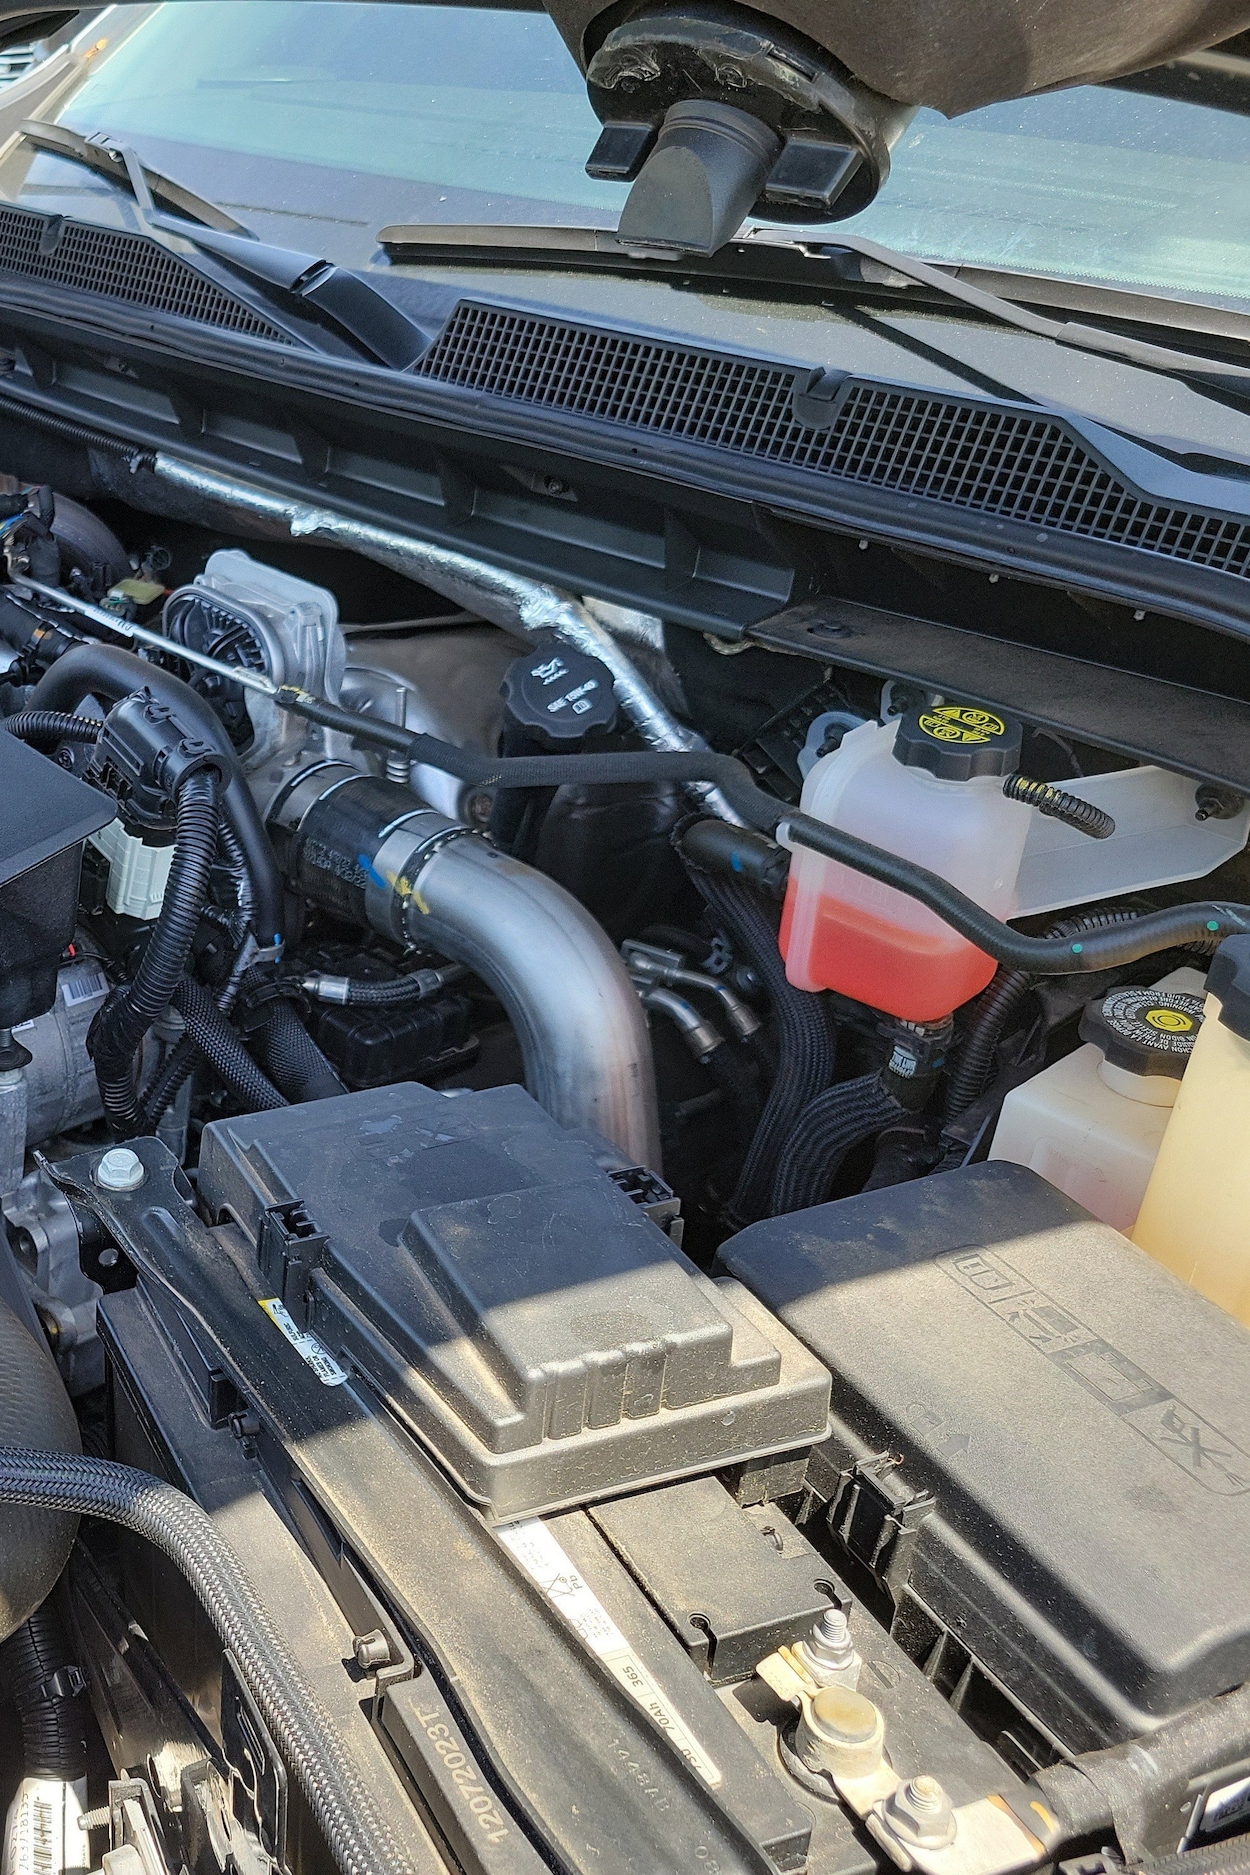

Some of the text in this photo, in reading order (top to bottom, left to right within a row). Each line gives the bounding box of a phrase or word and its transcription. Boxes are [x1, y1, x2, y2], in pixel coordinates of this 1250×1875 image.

[1141, 1039, 1169, 1051] AVANT
[569, 1575, 583, 1590] Pb
[622, 1665, 644, 1688] 365
[413, 1705, 509, 1843] 12072023T
